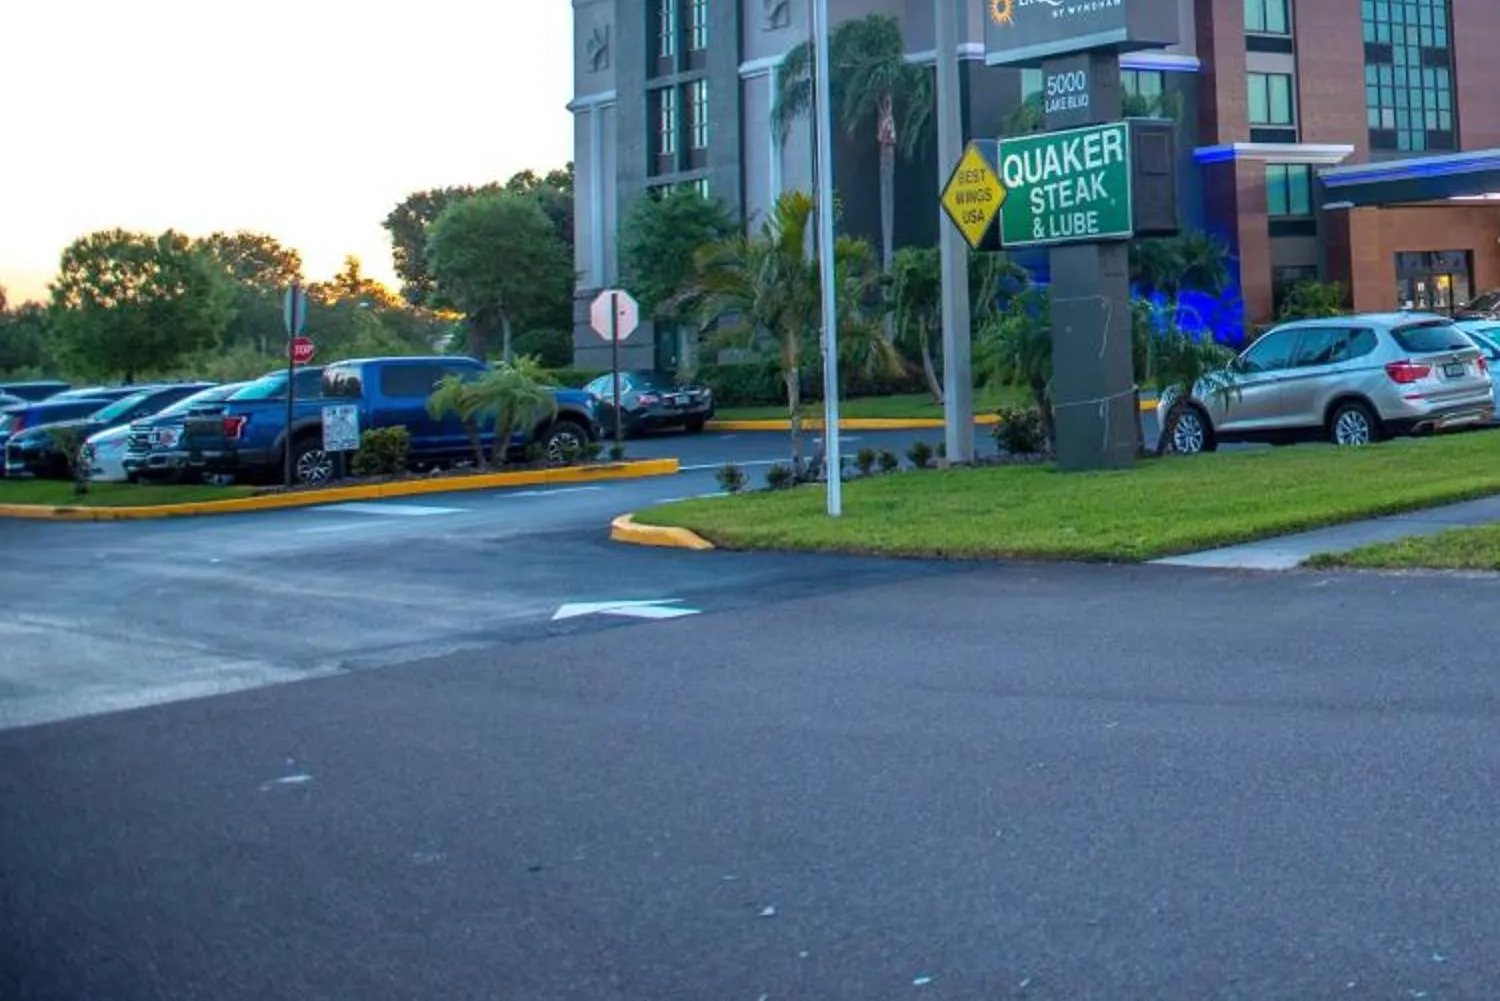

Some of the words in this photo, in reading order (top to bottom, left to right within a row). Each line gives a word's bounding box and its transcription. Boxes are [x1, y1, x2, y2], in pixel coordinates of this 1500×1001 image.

[1047, 70, 1087, 96] 5000
[1003, 128, 1123, 189] QUAKER
[958, 167, 985, 186] BEST
[955, 186, 993, 205] WINGS
[1030, 170, 1108, 215] STEAK
[962, 207, 985, 225] USA
[1032, 216, 1045, 238] &
[1049, 210, 1099, 237] LUBE
[292, 343, 314, 356] TOP
